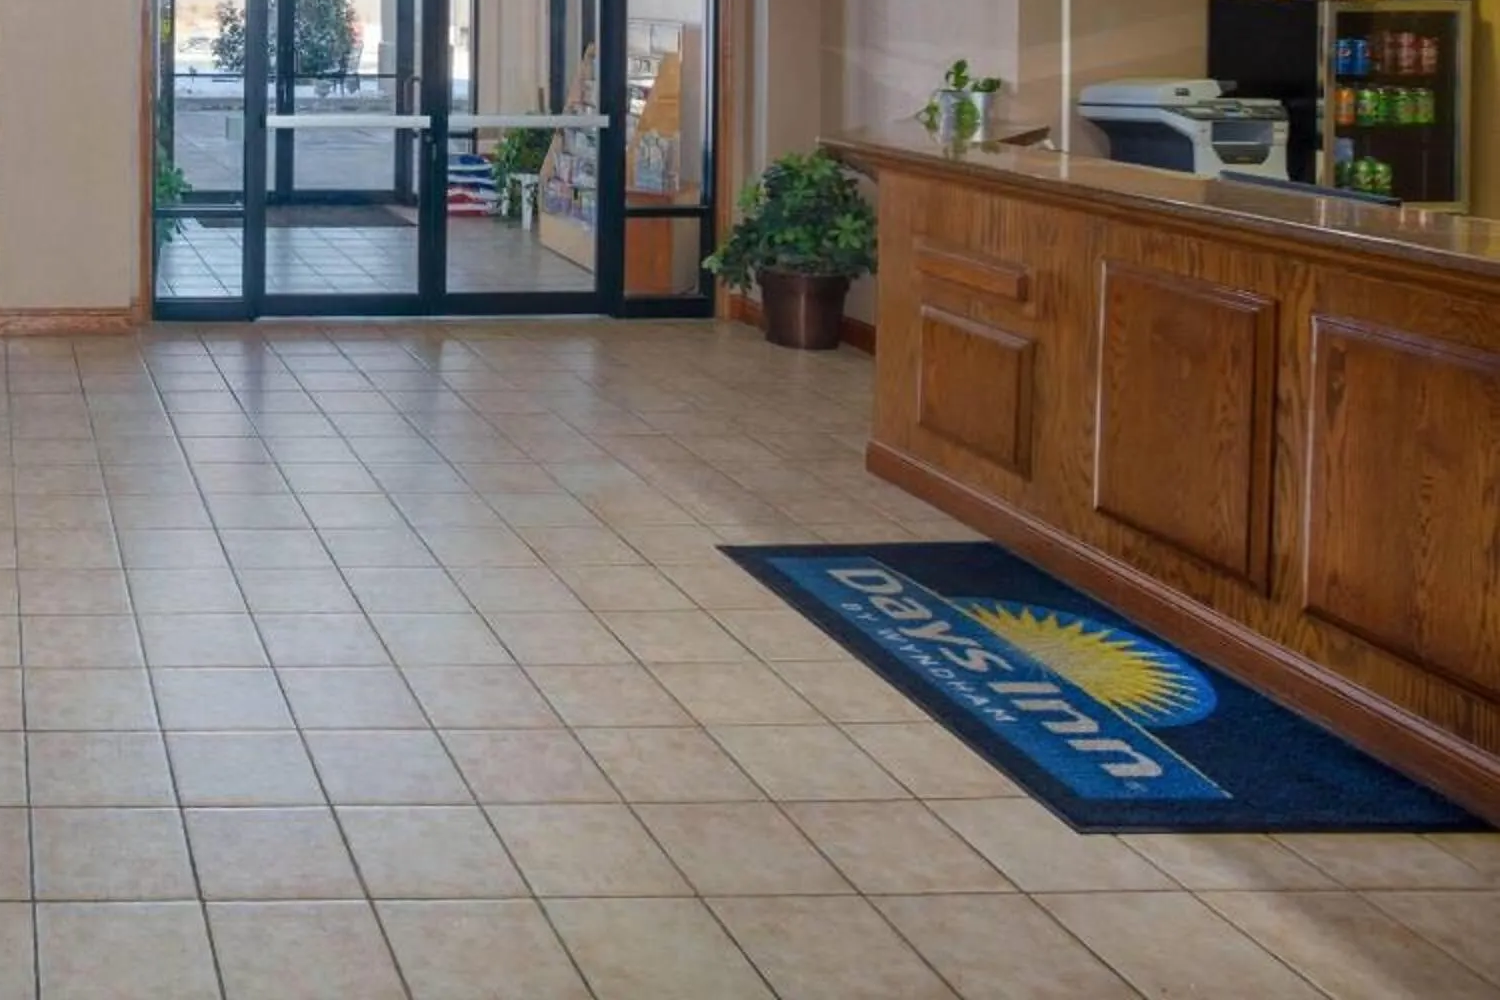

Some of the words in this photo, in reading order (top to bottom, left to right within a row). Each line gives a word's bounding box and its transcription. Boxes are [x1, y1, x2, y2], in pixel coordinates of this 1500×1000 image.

[828, 568, 1014, 673] Days
[986, 682, 1163, 778] Inn
[841, 602, 878, 623] BY
[877, 627, 1018, 723] WYNDHAM
